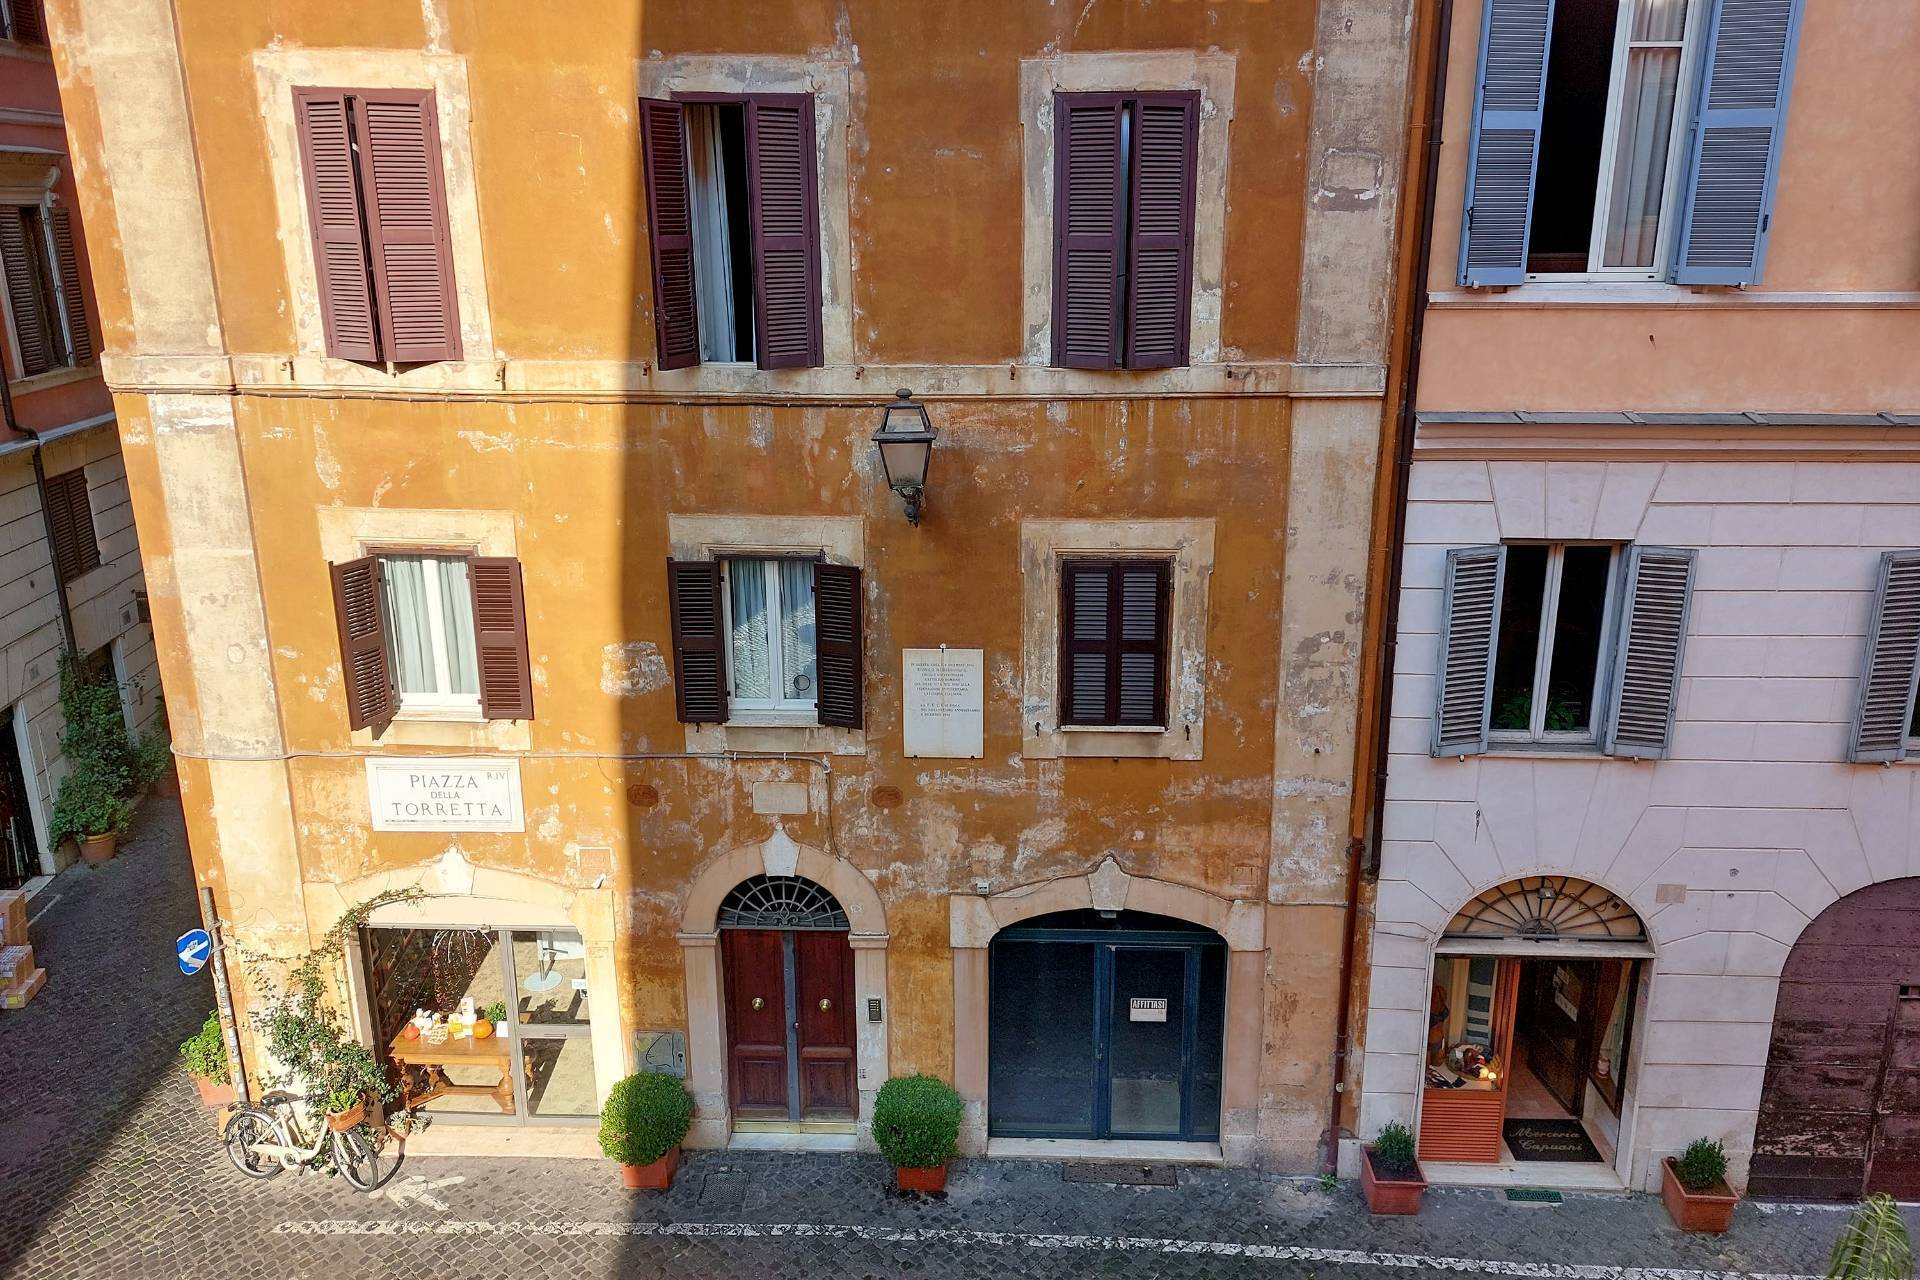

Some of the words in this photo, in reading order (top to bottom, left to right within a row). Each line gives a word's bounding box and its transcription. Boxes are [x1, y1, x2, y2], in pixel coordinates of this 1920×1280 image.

[409, 774, 479, 789] PIAZZA
[430, 791, 461, 800] DELLA
[392, 802, 503, 817] TORRETTA
[1132, 1000, 1165, 1009] AFFITTASI
[1509, 1127, 1581, 1139] Merceria
[1518, 1139, 1583, 1152] Capuani
